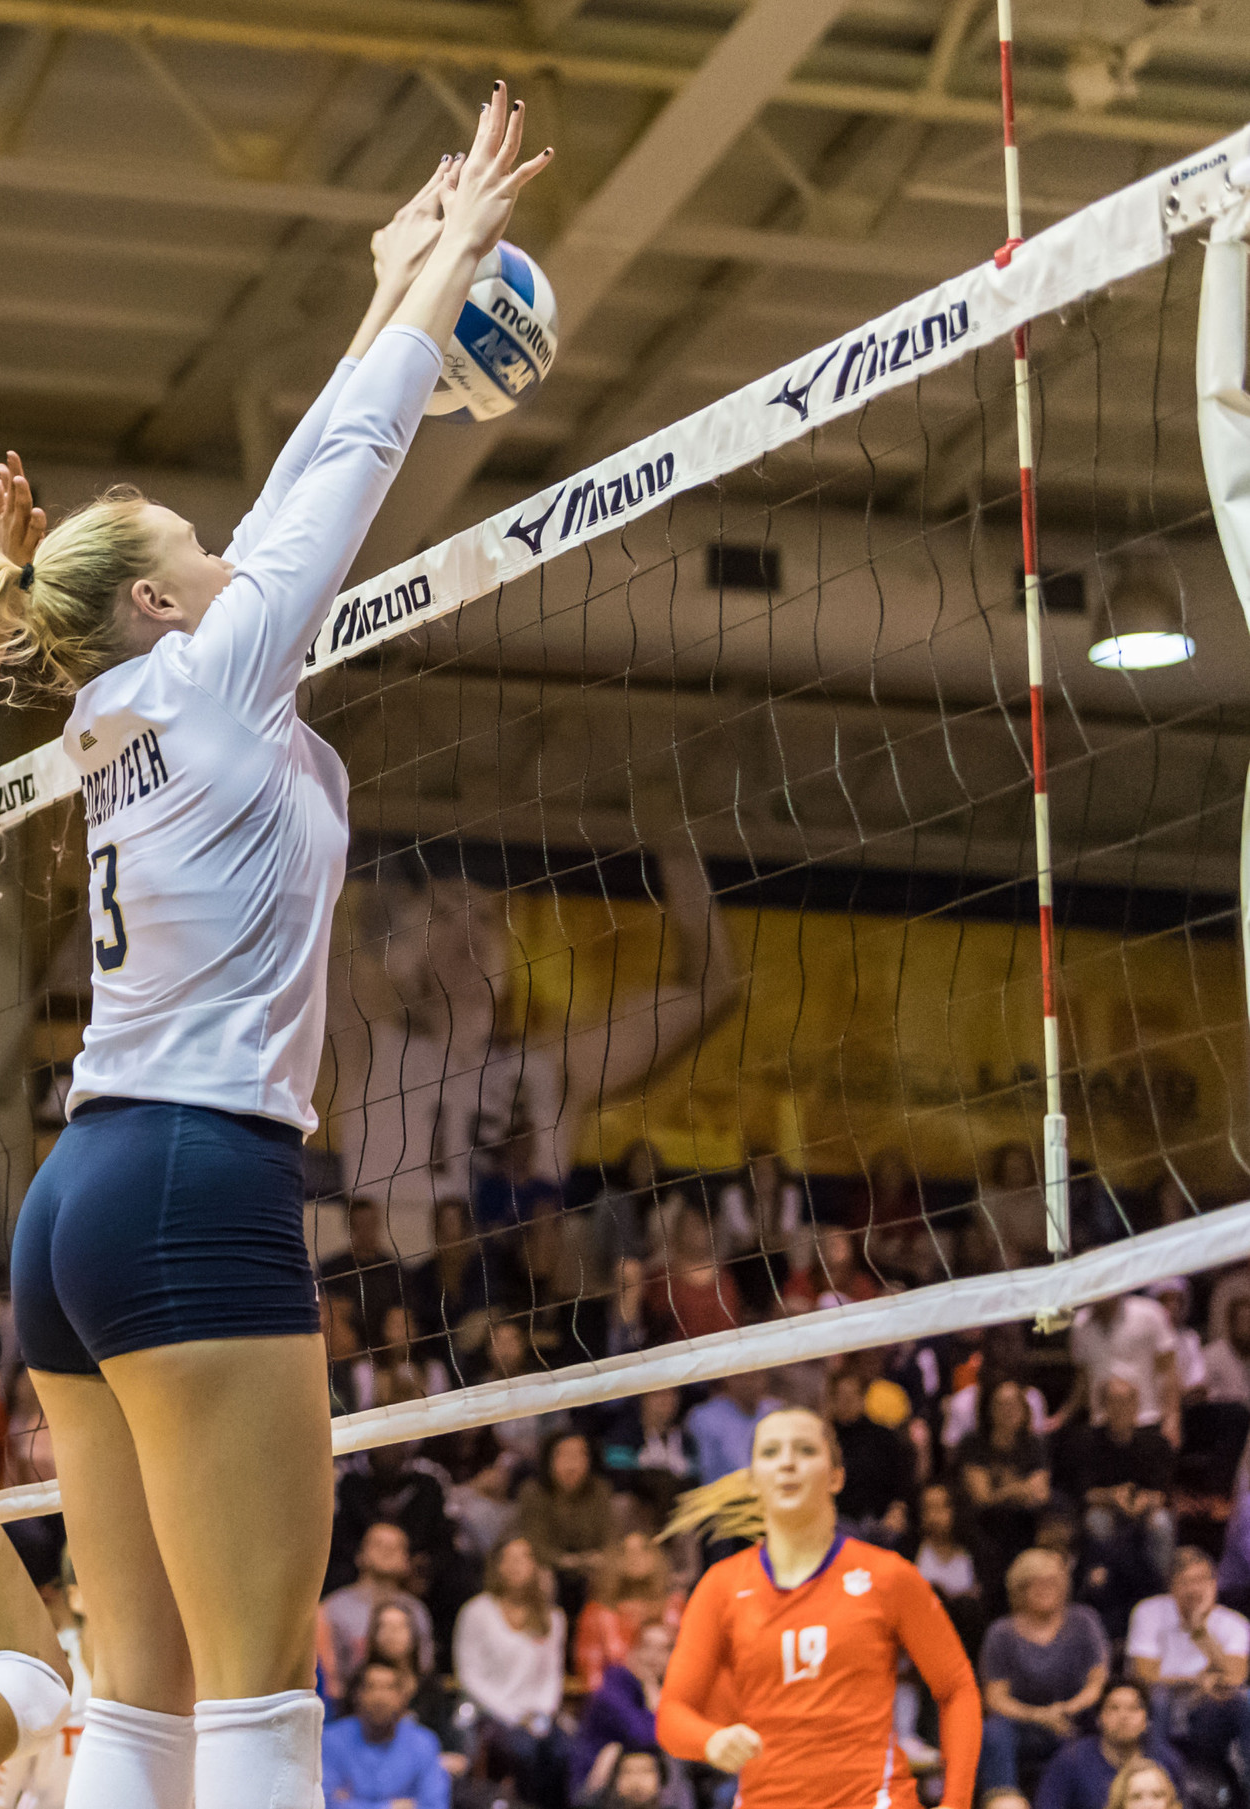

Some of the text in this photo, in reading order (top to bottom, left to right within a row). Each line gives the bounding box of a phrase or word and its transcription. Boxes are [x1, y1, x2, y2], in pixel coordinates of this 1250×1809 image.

[490, 297, 552, 370] molten
[119, 728, 169, 811] TECH
[91, 841, 129, 974] 3
[781, 1624, 828, 1685] 19
